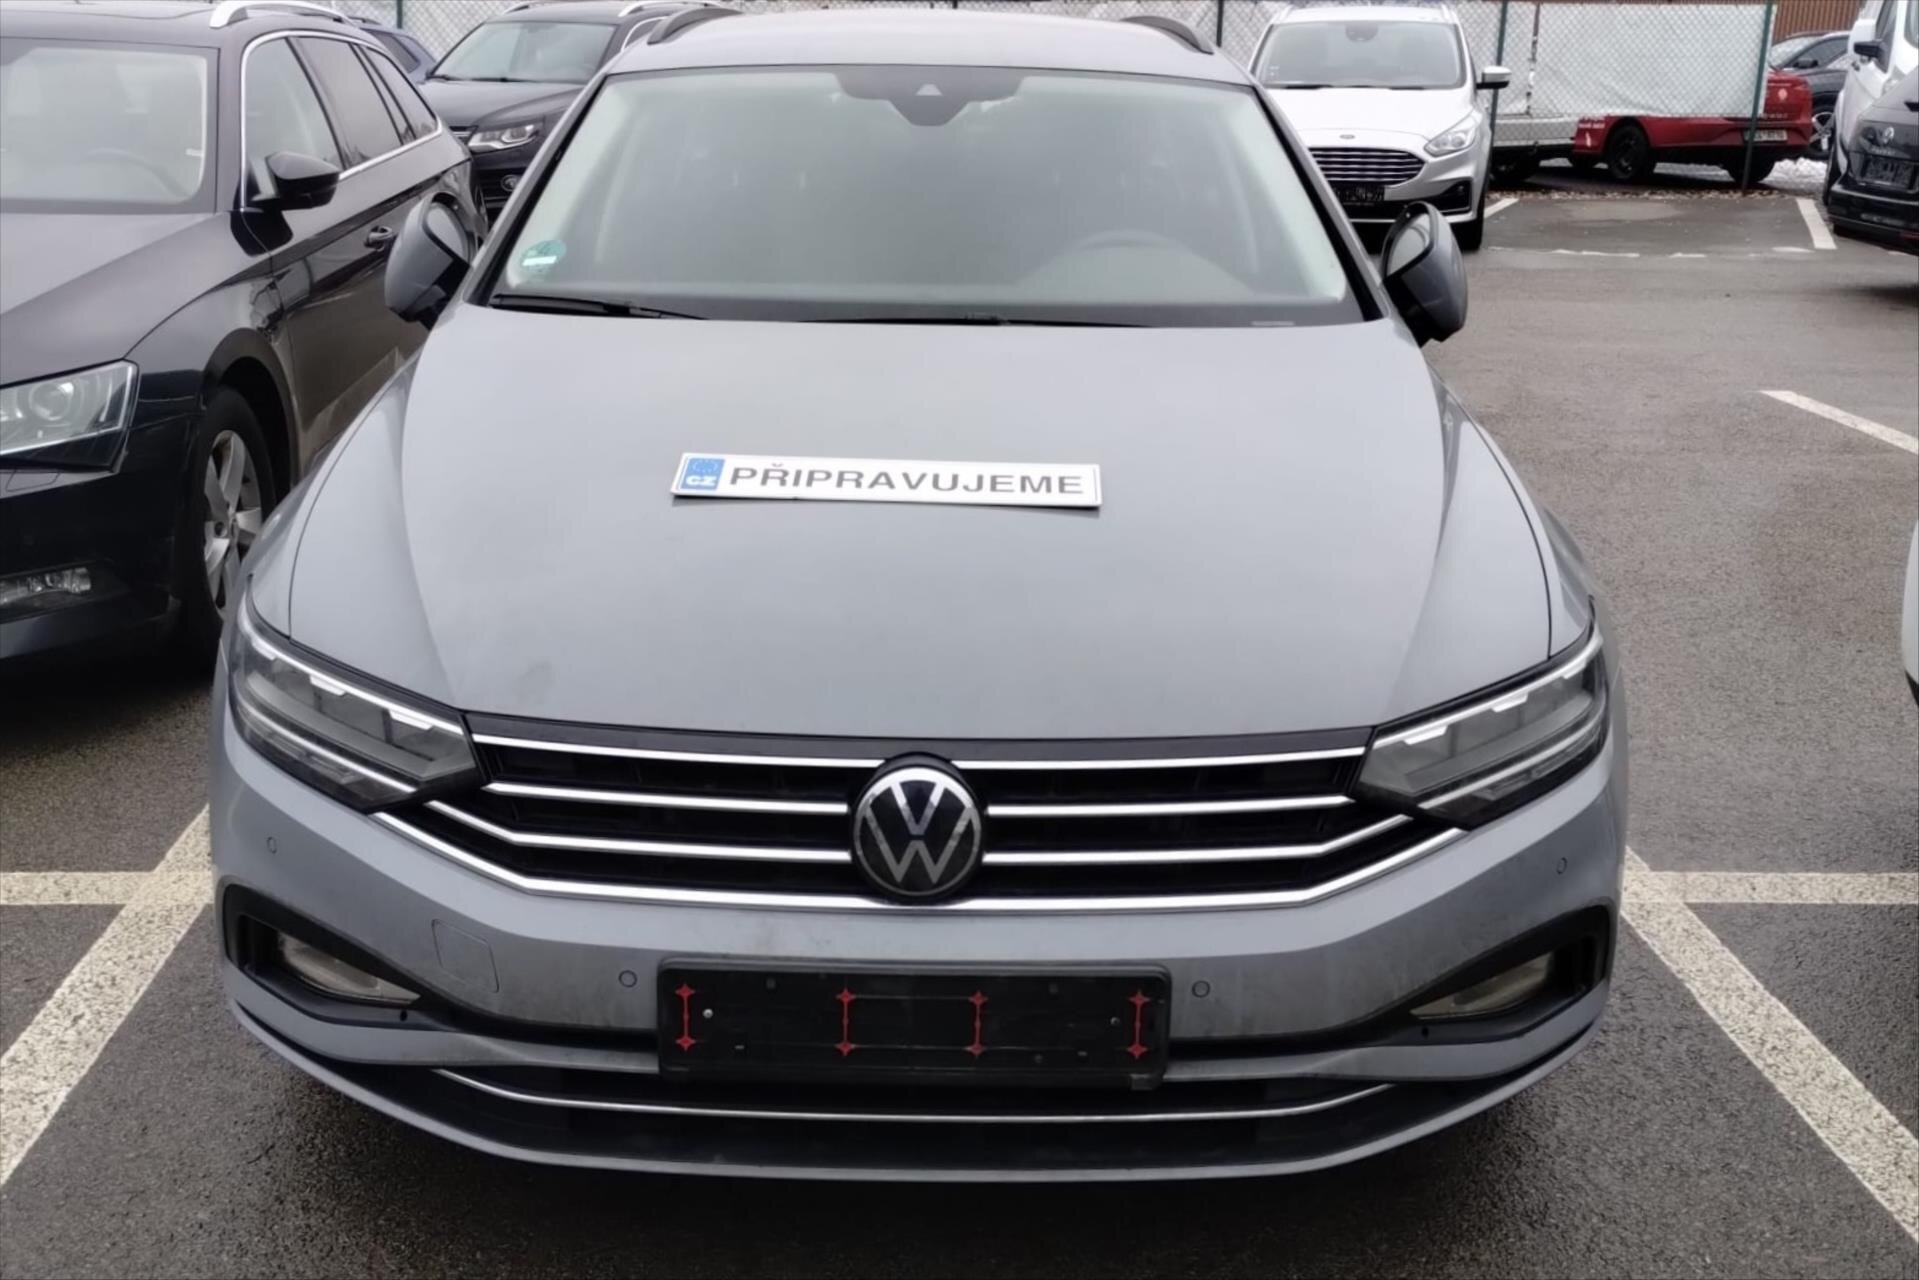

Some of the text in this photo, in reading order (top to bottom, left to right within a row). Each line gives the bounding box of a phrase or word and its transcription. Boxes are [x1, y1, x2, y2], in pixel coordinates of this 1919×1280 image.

[685, 463, 1083, 494] CZ PŘIPRAVUJEME
[856, 769, 979, 891] VW
